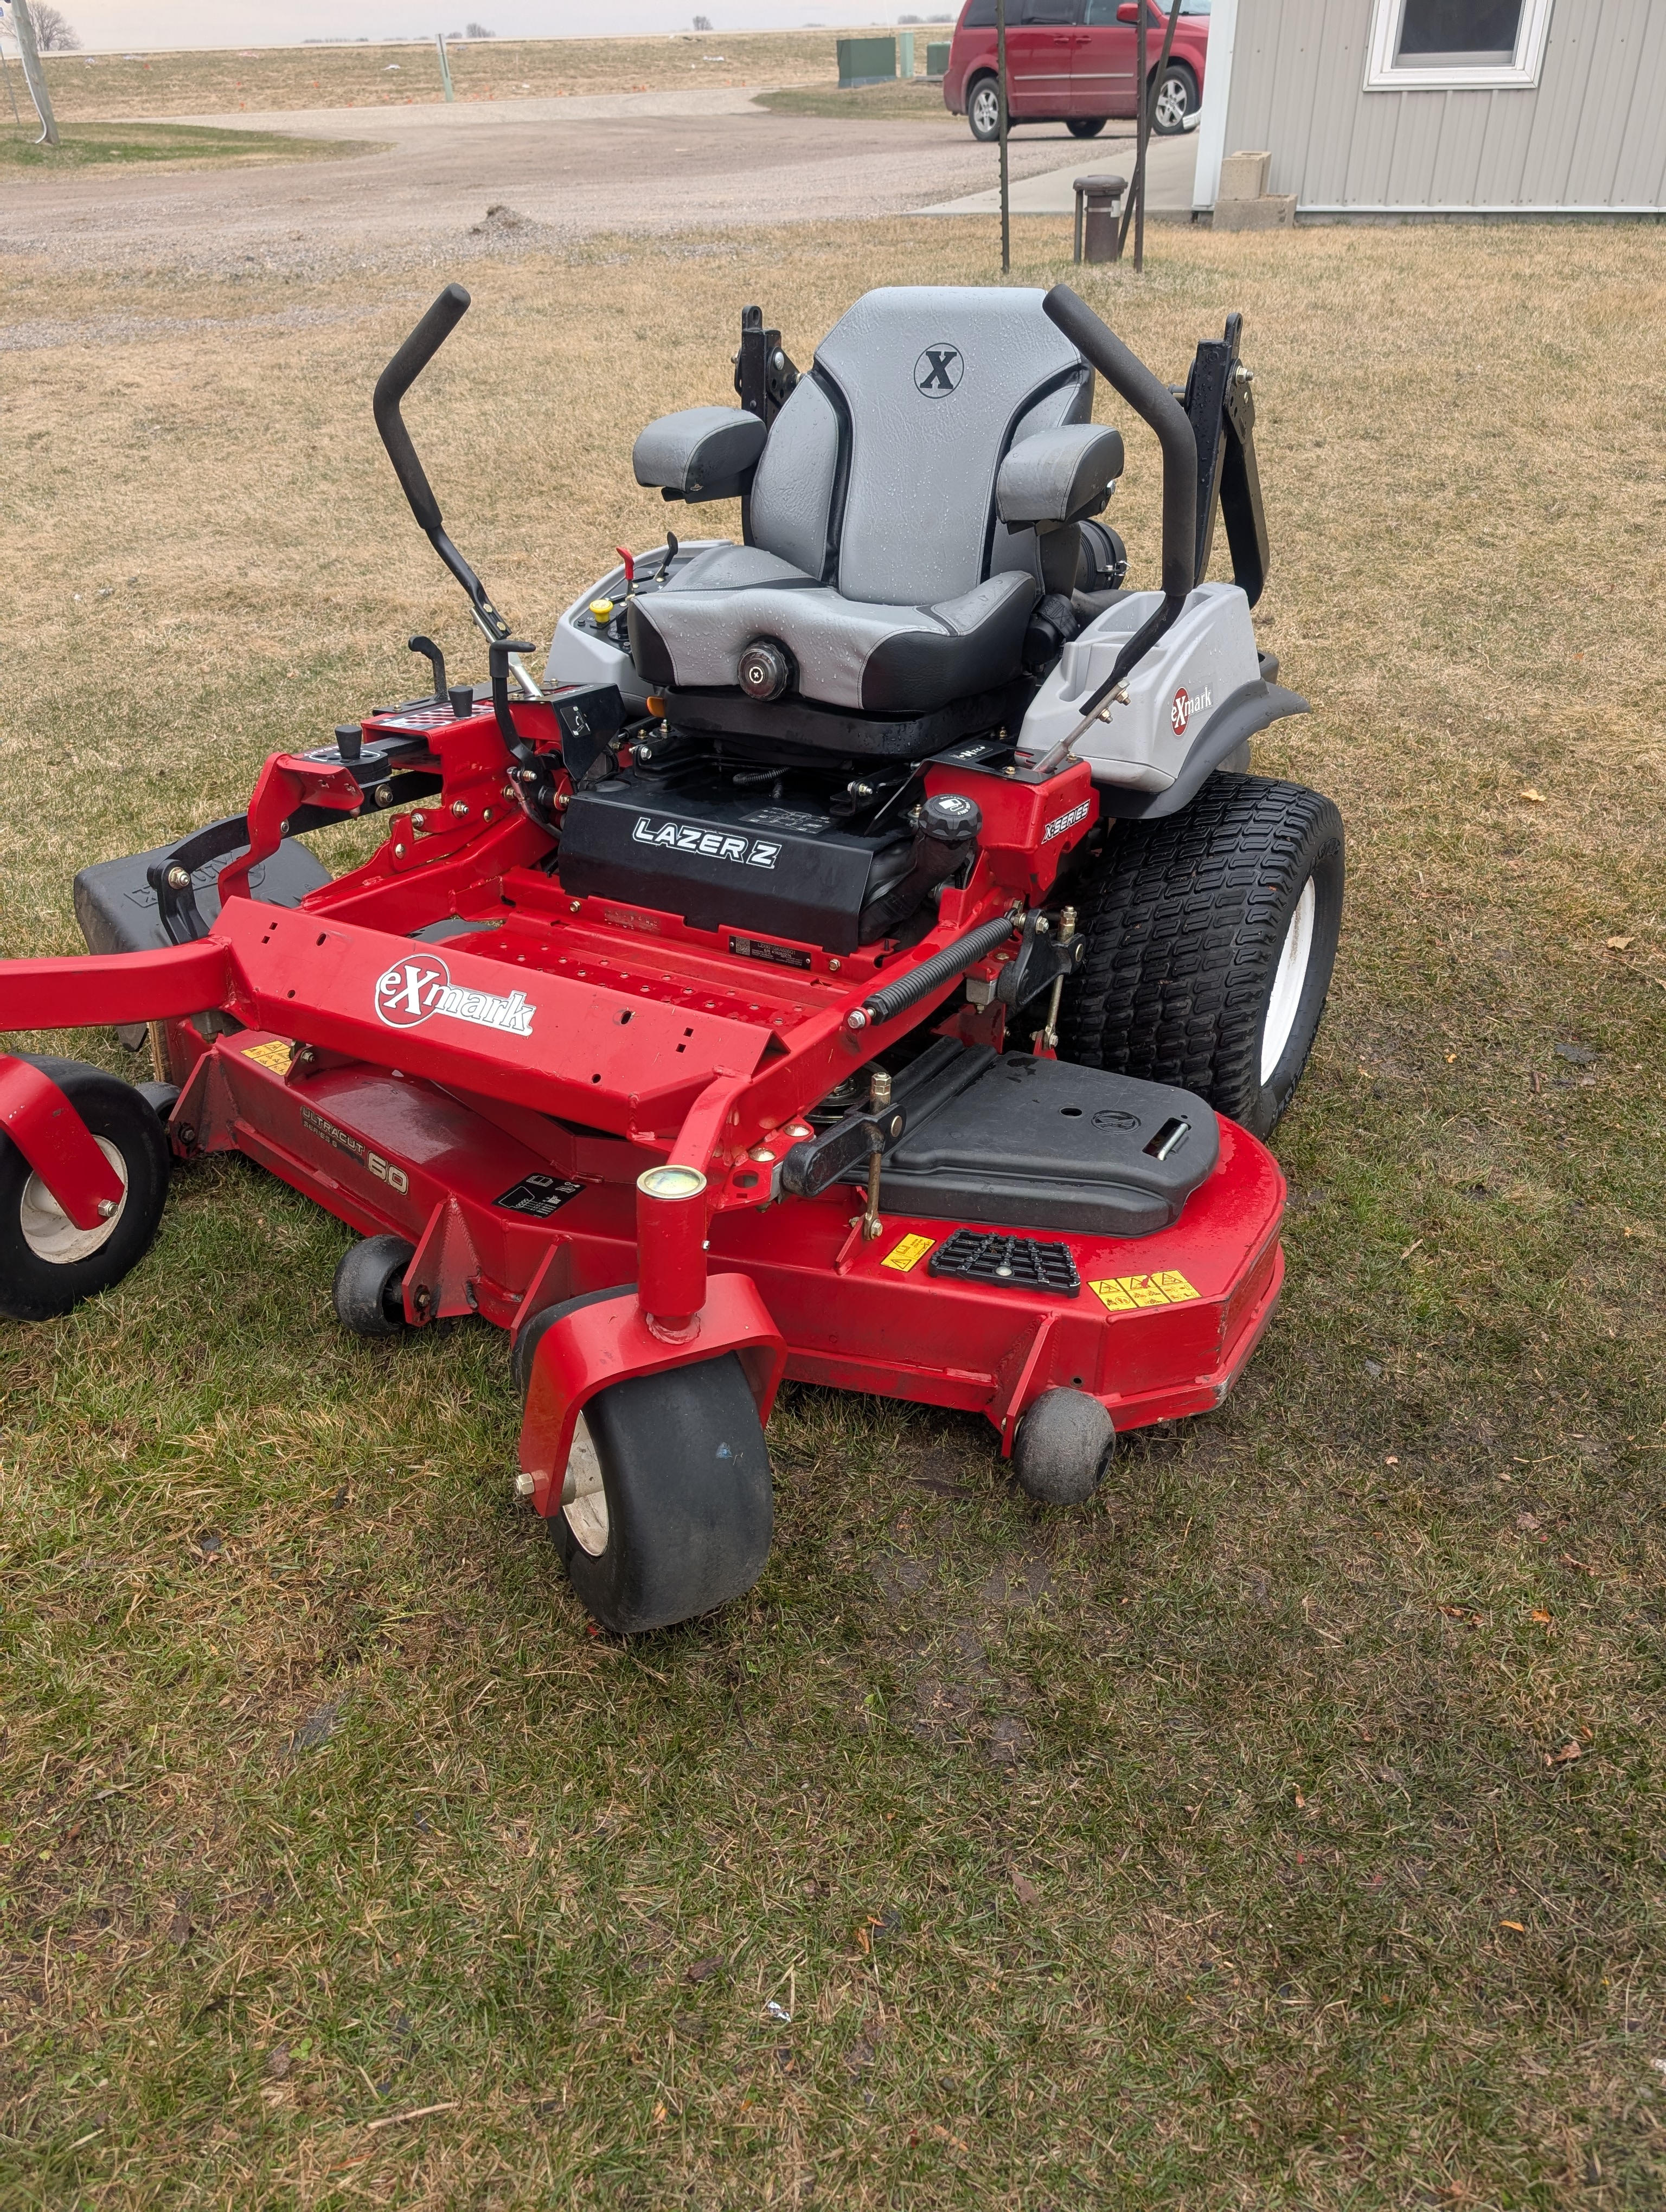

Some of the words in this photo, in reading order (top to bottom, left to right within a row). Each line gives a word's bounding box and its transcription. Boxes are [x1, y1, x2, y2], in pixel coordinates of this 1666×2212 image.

[919, 351, 957, 390] X
[1171, 685, 1212, 729] eXmark
[635, 820, 746, 859] LAZER
[750, 844, 778, 865] Z
[379, 964, 535, 1032] eXmark
[302, 1105, 365, 1155] ULTRACUT
[303, 1121, 330, 1143] SERIES
[332, 1140, 338, 1148] 6
[368, 1150, 408, 1195] 60
